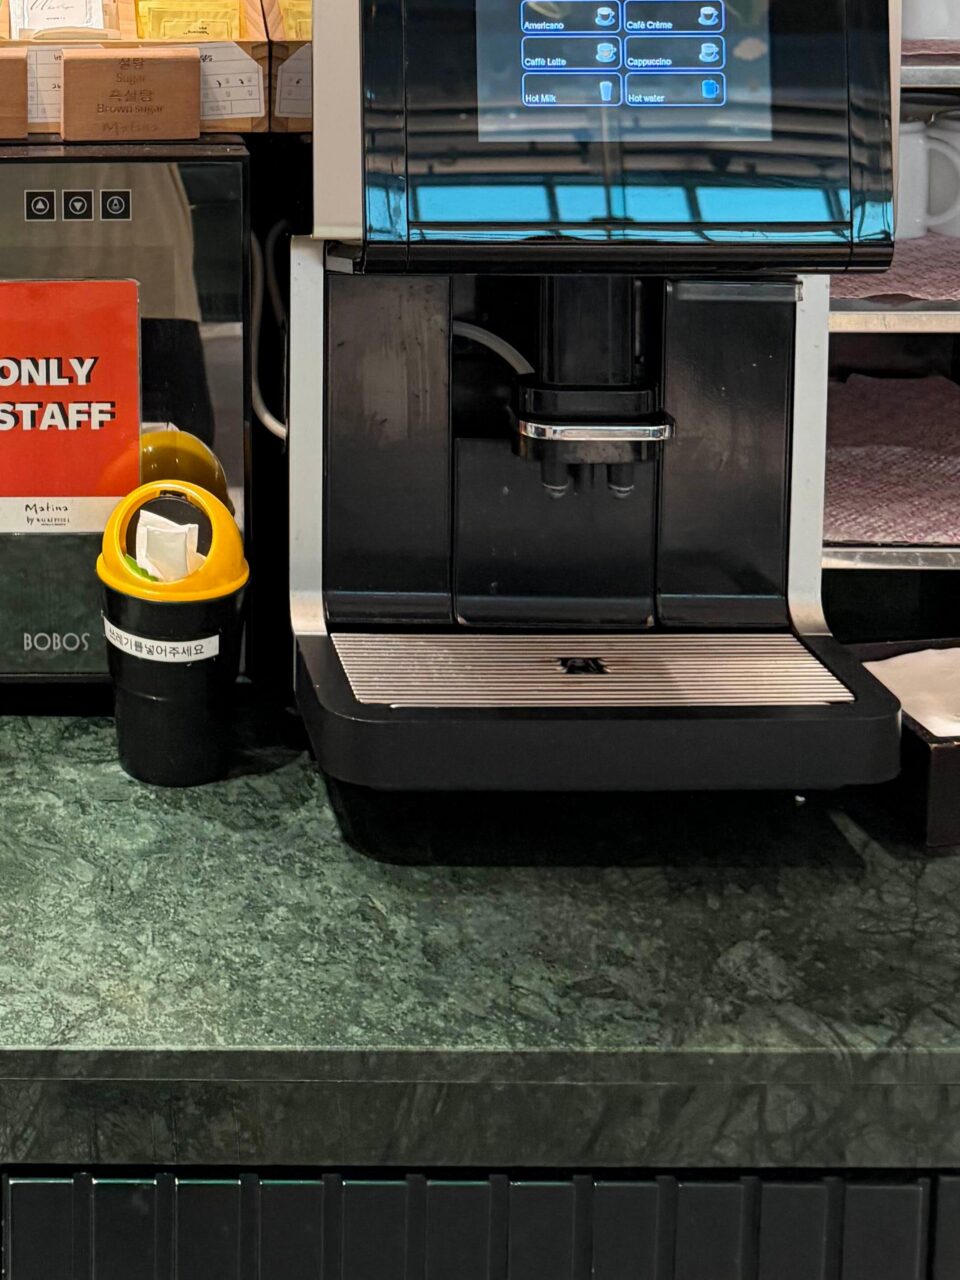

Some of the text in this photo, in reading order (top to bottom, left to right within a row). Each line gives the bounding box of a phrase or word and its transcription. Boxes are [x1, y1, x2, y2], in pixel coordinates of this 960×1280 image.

[523, 21, 565, 30] Americano
[627, 58, 672, 68] Cappuccino
[525, 94, 557, 103] Hot Milk
[628, 94, 665, 103] Hot water
[96, 103, 164, 116] Brown sugar
[23, 632, 90, 652] BOBOS
